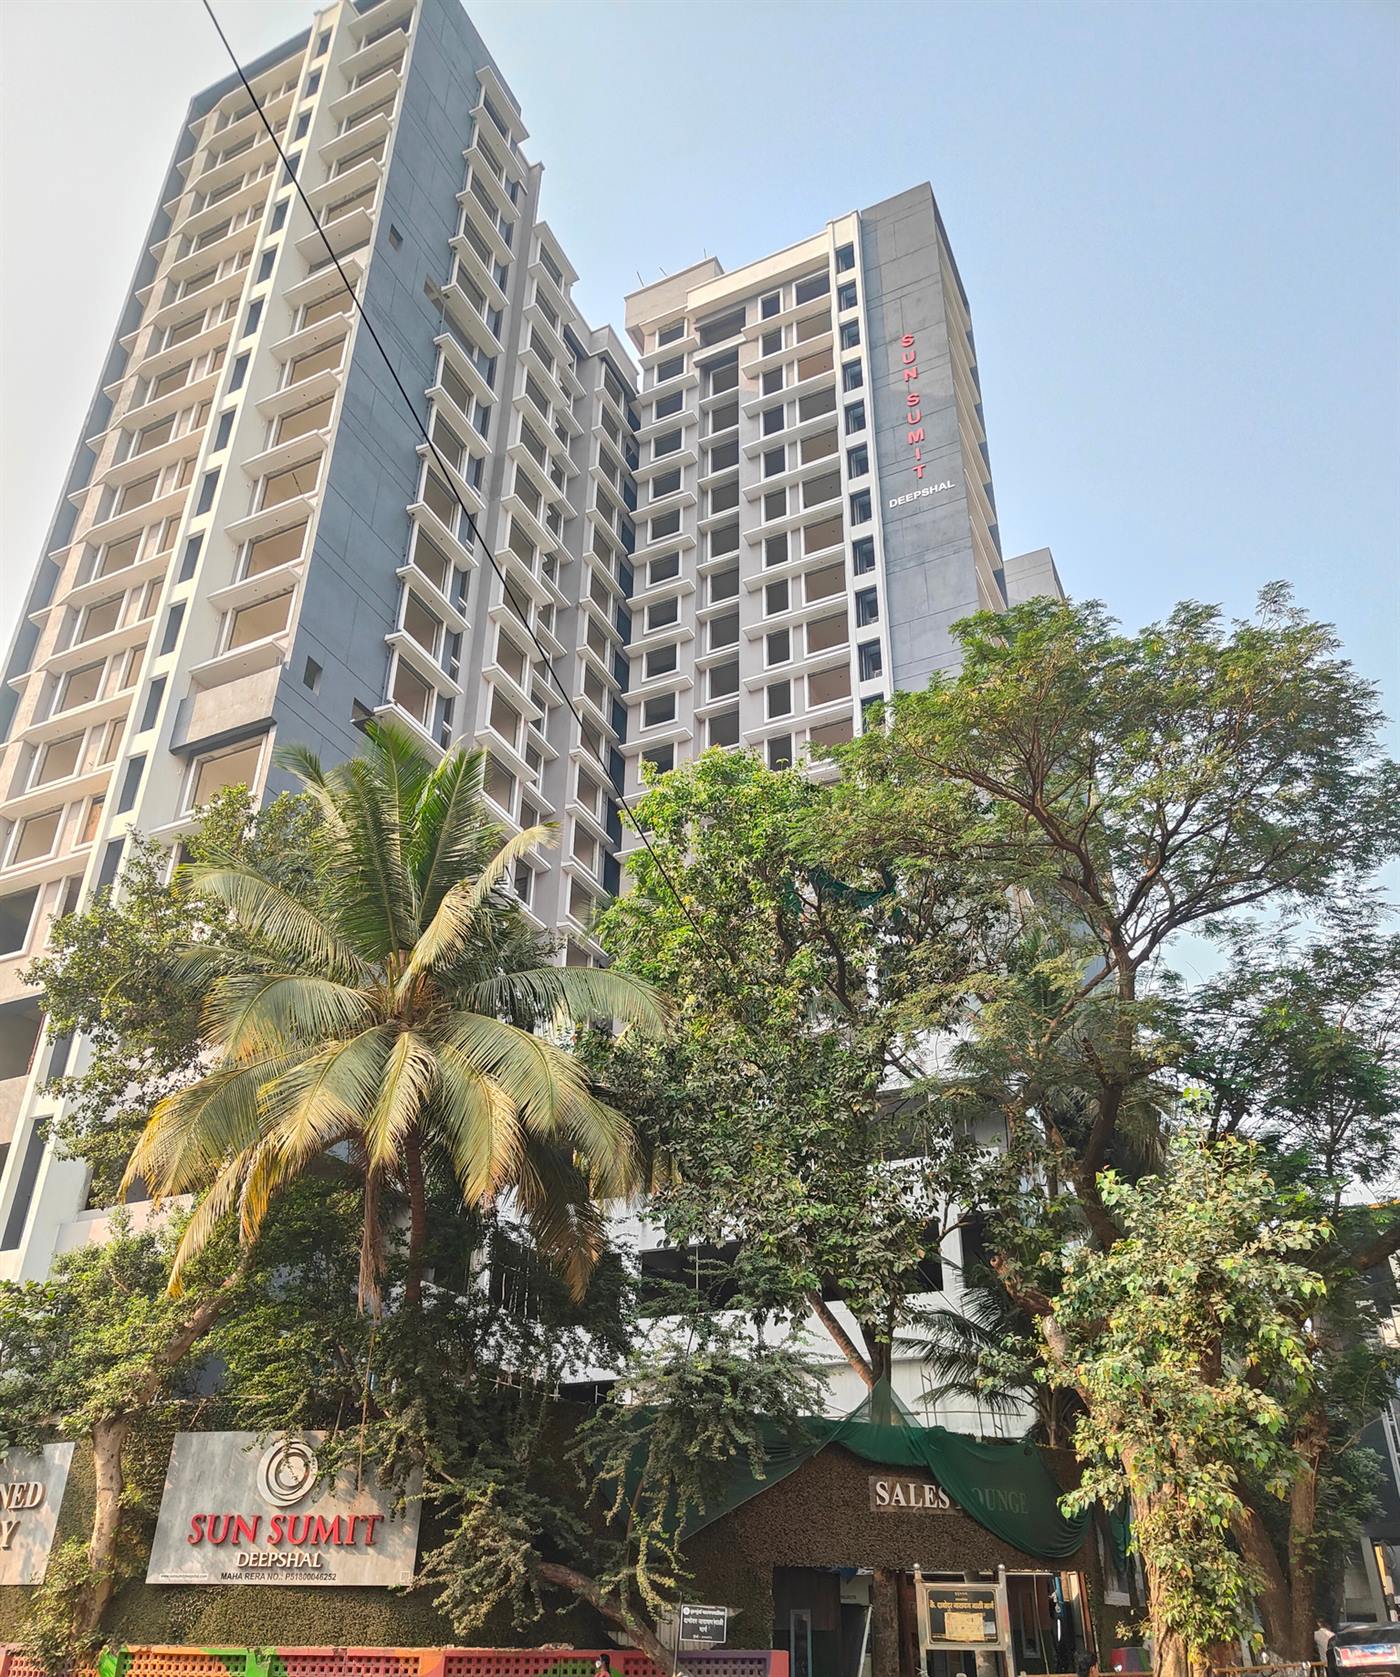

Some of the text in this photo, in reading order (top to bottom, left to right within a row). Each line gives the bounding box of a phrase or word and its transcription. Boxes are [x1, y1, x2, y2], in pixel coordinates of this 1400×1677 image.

[901, 334, 926, 479] SUN SUMIT
[889, 480, 955, 508] DEEPSHAL
[876, 1481, 950, 1509] SALES
[187, 1513, 384, 1546] SUN SUMIT
[236, 1552, 323, 1569] DEEPSHAL
[220, 1572, 243, 1580] MAHA
[244, 1572, 265, 1580] RERA
